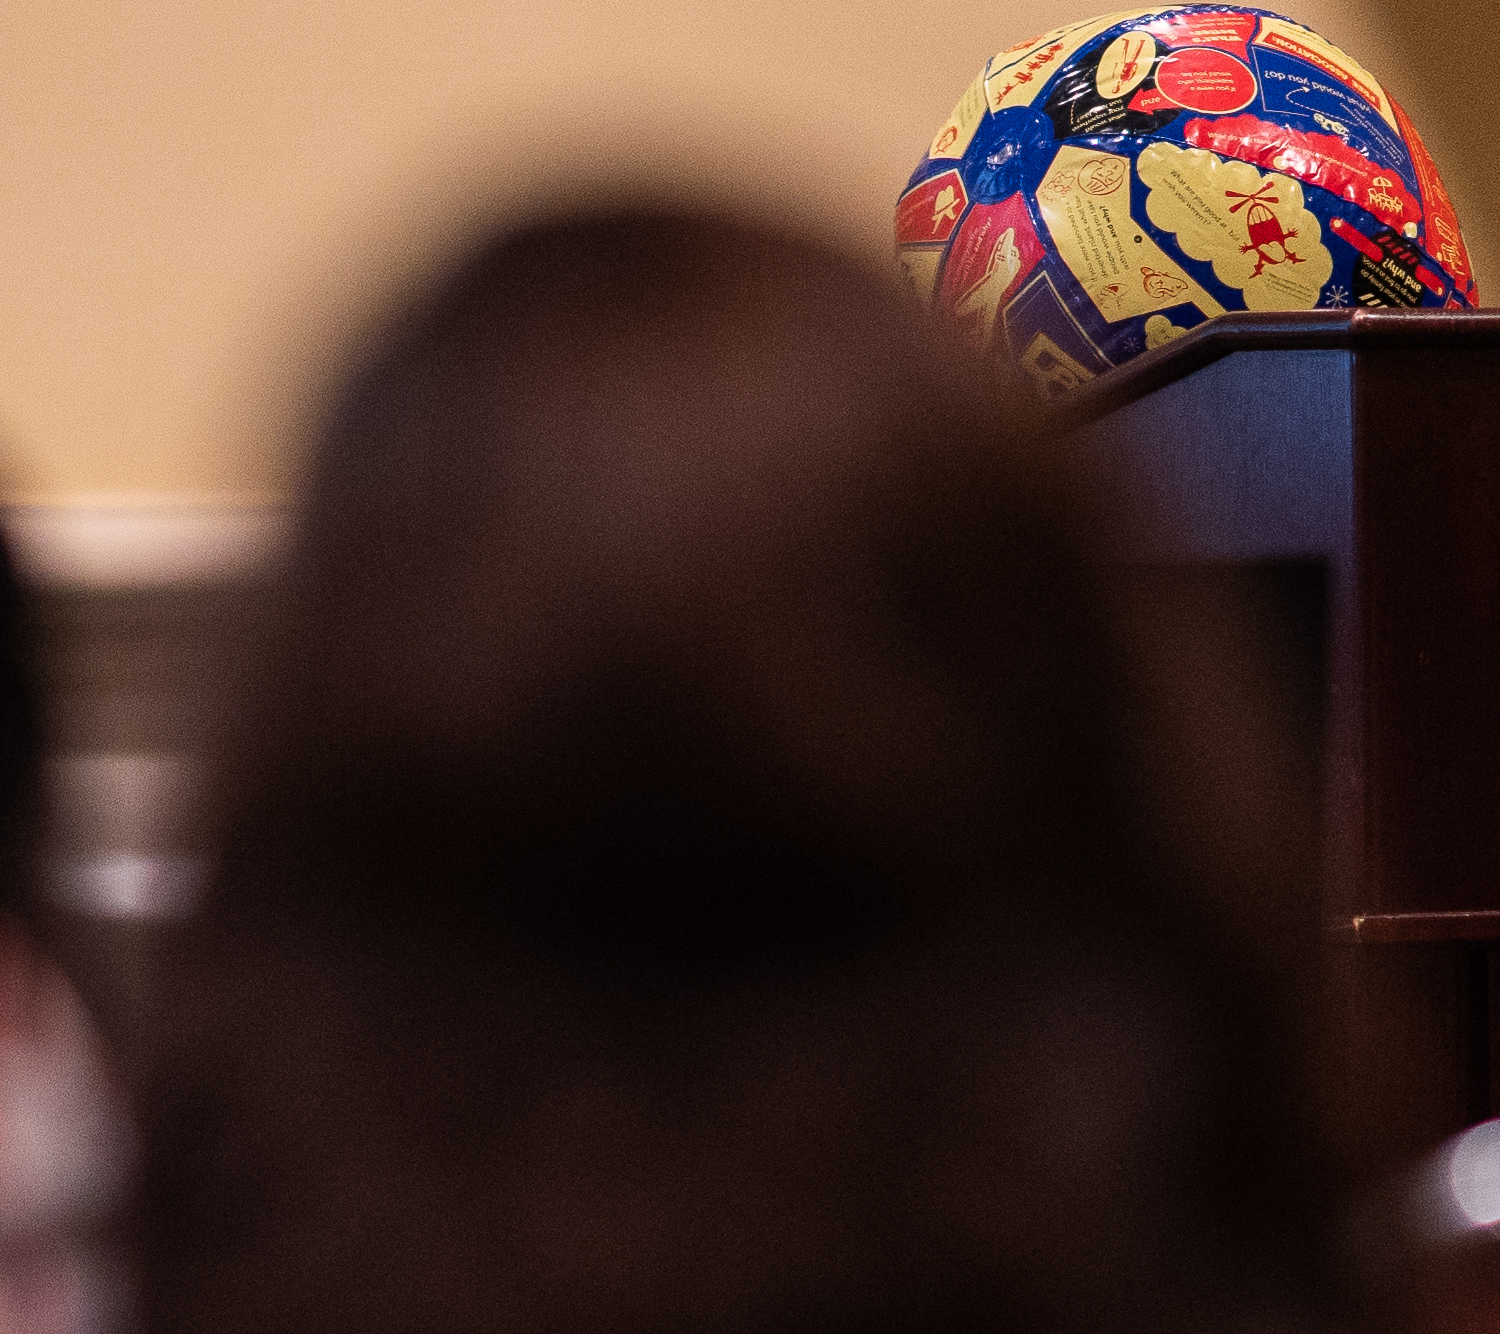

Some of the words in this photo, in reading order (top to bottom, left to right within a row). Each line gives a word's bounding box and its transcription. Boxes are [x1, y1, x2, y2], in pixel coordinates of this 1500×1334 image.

[1192, 35, 1243, 43] What's
[1287, 75, 1311, 85] you
[1310, 82, 1347, 99] would
[1350, 79, 1377, 103] FREE
[1140, 96, 1161, 106] and
[1163, 178, 1177, 191] wish
[1175, 191, 1187, 203] you
[1171, 169, 1187, 186] What
[1185, 186, 1196, 196] are
[1193, 195, 1206, 207] you
[1204, 207, 1222, 223] good
[1094, 214, 1102, 226] you
[1099, 205, 1111, 223] why?
[1097, 228, 1109, 249] would
[1107, 224, 1117, 238] and
[974, 237, 983, 252] and
[1081, 246, 1089, 261] were
[1088, 263, 1096, 275] you
[1092, 248, 1107, 278] deserted
[1106, 251, 1120, 274] people
[1382, 258, 1406, 279] why?
[1368, 275, 1384, 292] family
[1404, 275, 1422, 292] and
[1407, 293, 1417, 303] you
